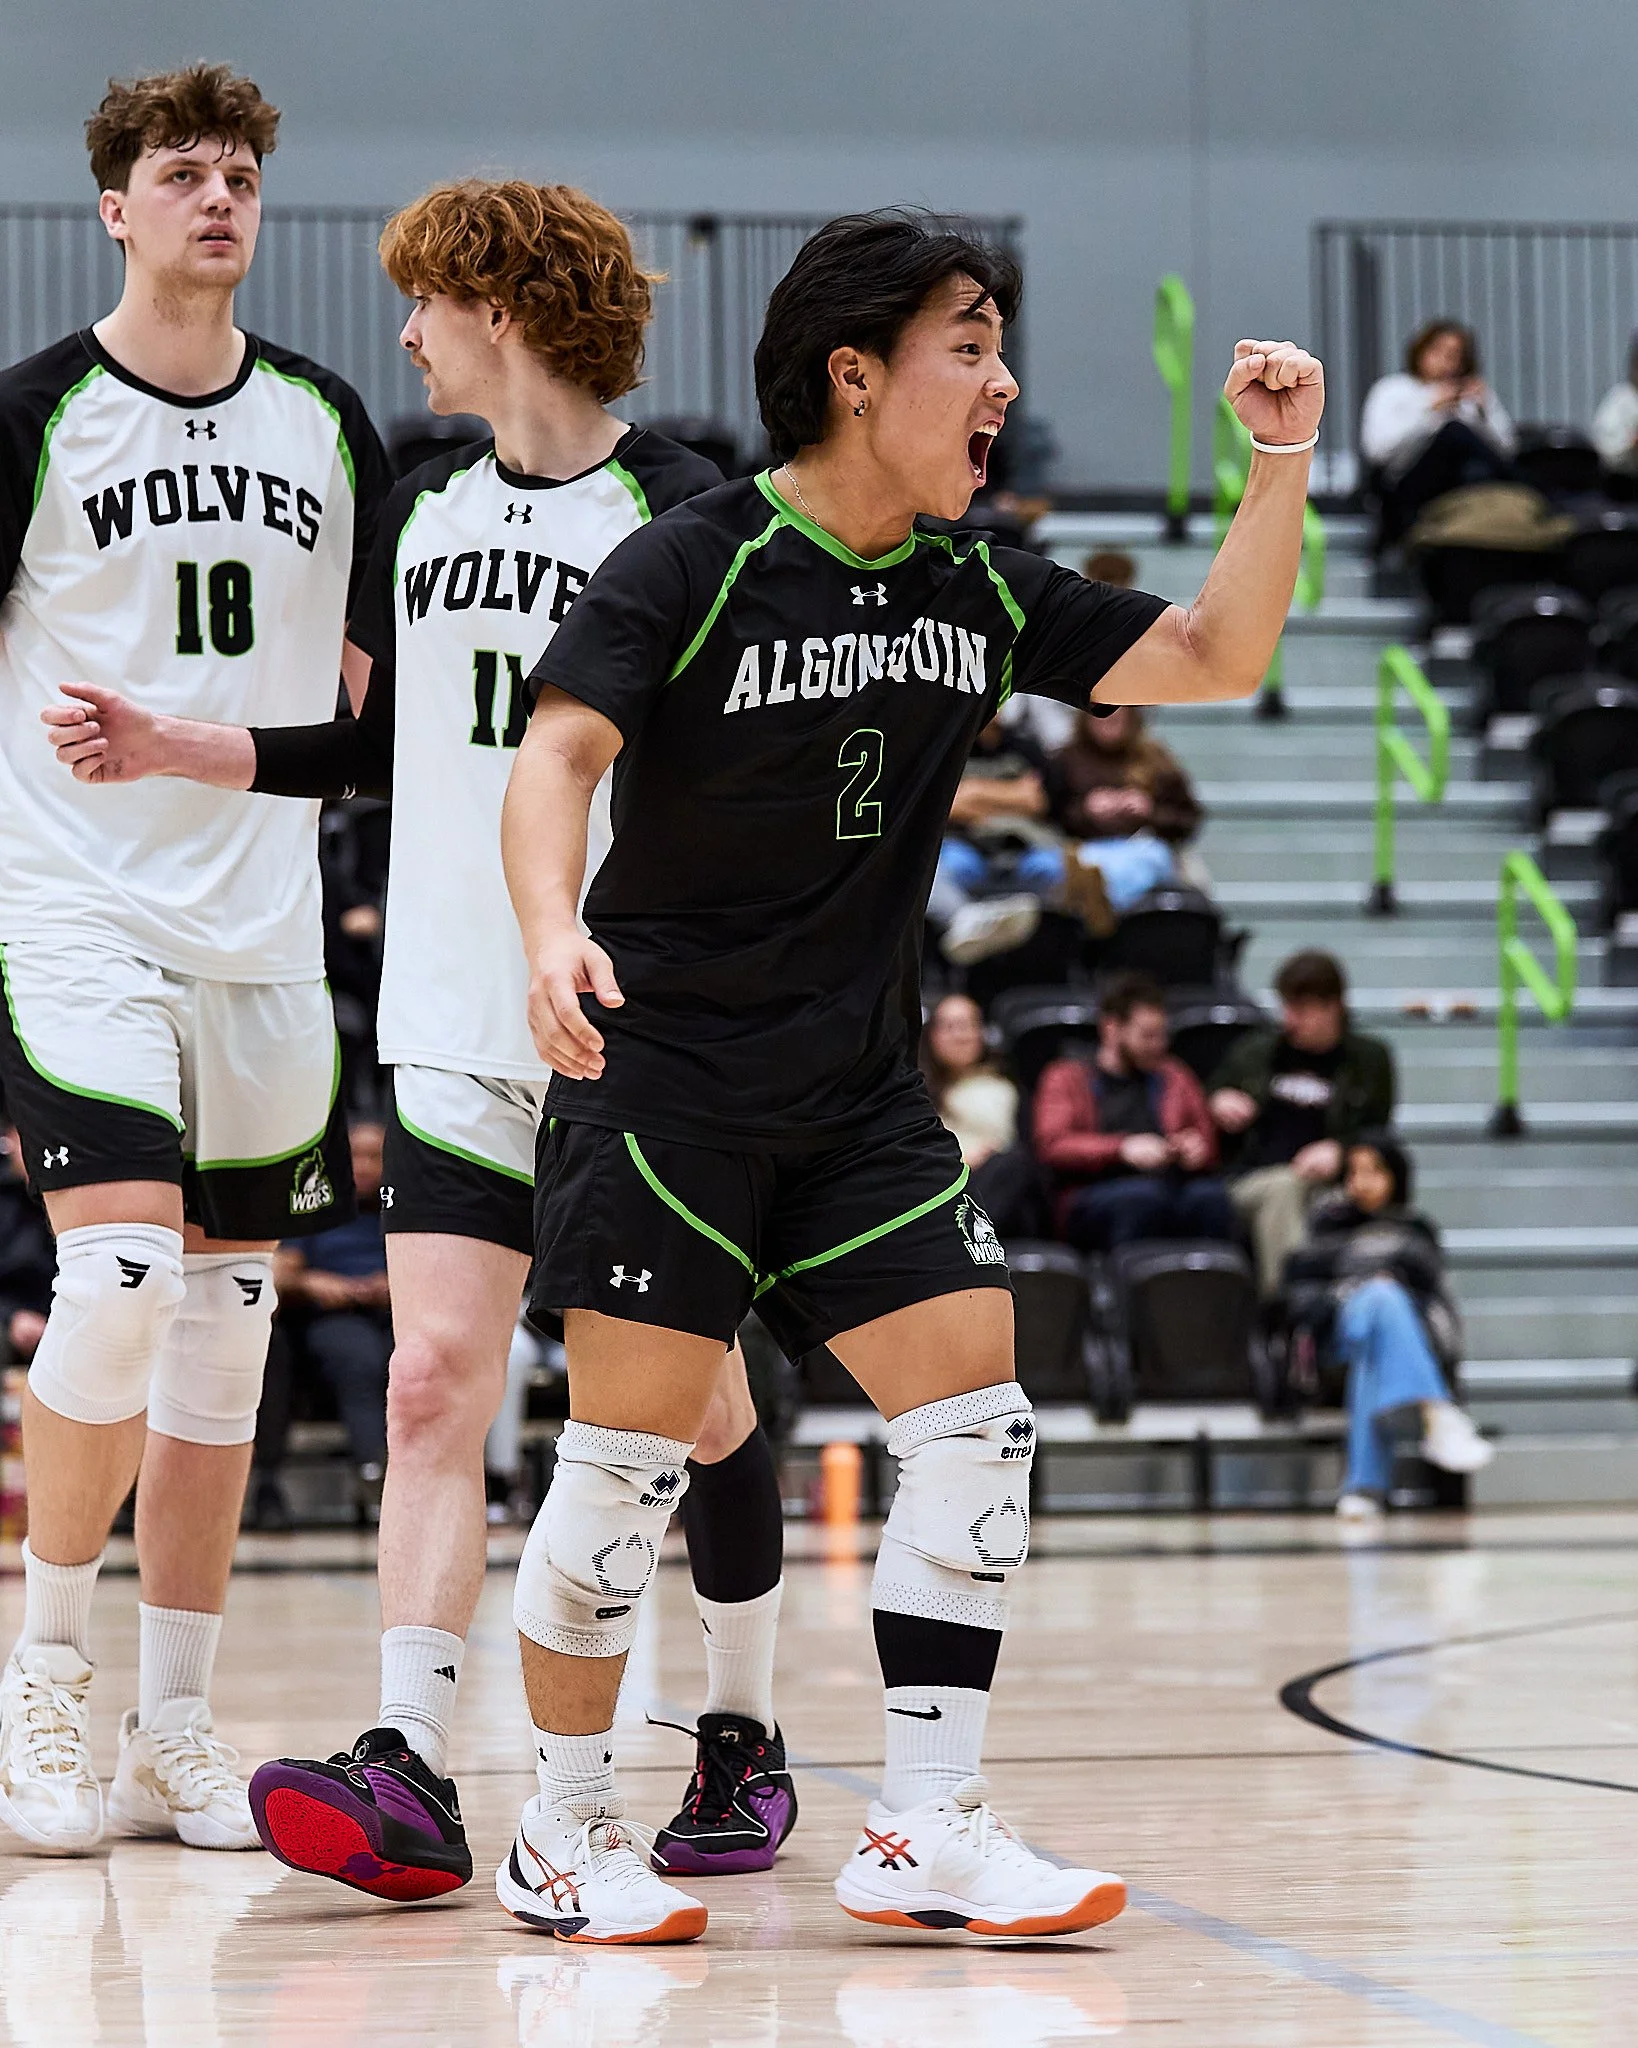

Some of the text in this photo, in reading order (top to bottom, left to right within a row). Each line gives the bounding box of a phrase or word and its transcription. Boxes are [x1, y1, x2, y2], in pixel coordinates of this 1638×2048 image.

[82, 464, 323, 553] WOLVES
[175, 559, 255, 656] 18
[404, 548, 590, 627] WOLVE
[468, 648, 530, 750] 11
[723, 616, 987, 714] ALGONQUIN
[836, 728, 884, 840] 2
